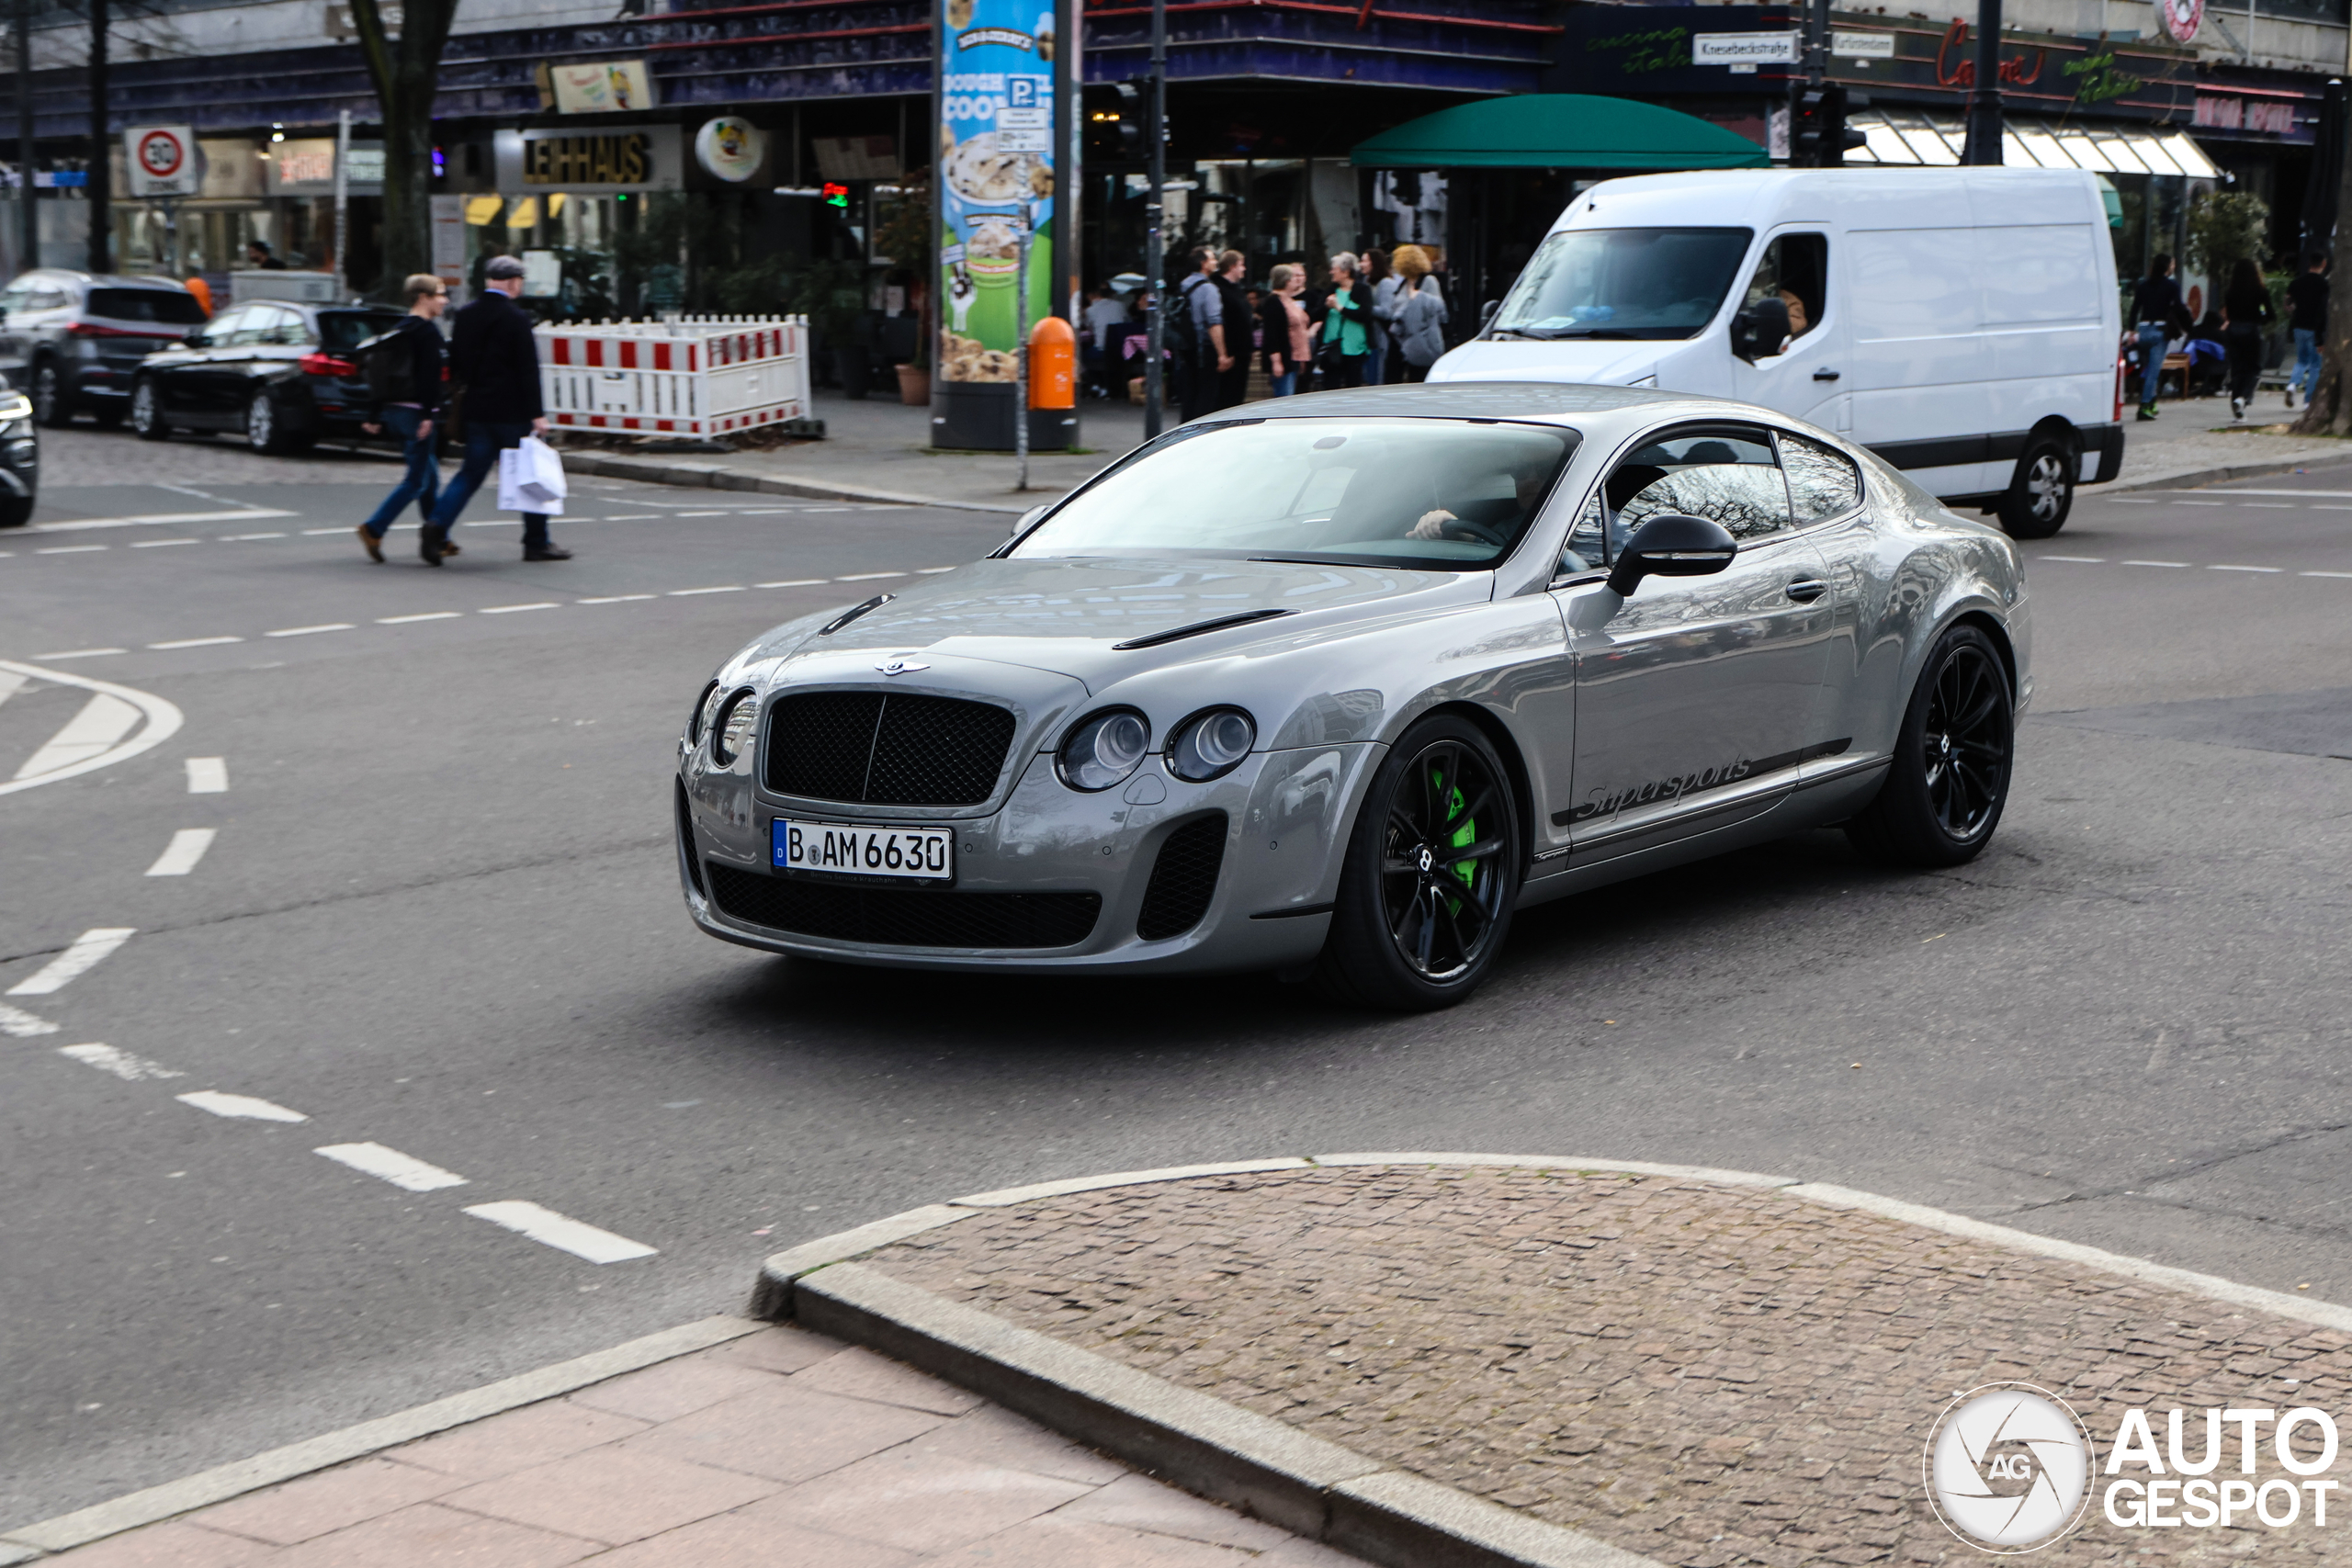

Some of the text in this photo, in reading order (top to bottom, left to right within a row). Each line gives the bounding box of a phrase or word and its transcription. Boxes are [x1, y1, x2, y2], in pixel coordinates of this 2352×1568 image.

[1701, 41, 1790, 58] Knesebeckstraße
[1012, 80, 1033, 106] P
[148, 142, 176, 164] 30
[524, 134, 650, 184] LEIHHAUS
[1576, 753, 1753, 823] Supersports
[777, 848, 783, 858] D
[788, 828, 945, 871] B AM 6630
[810, 871, 897, 885] Bentley Service Krauthahn
